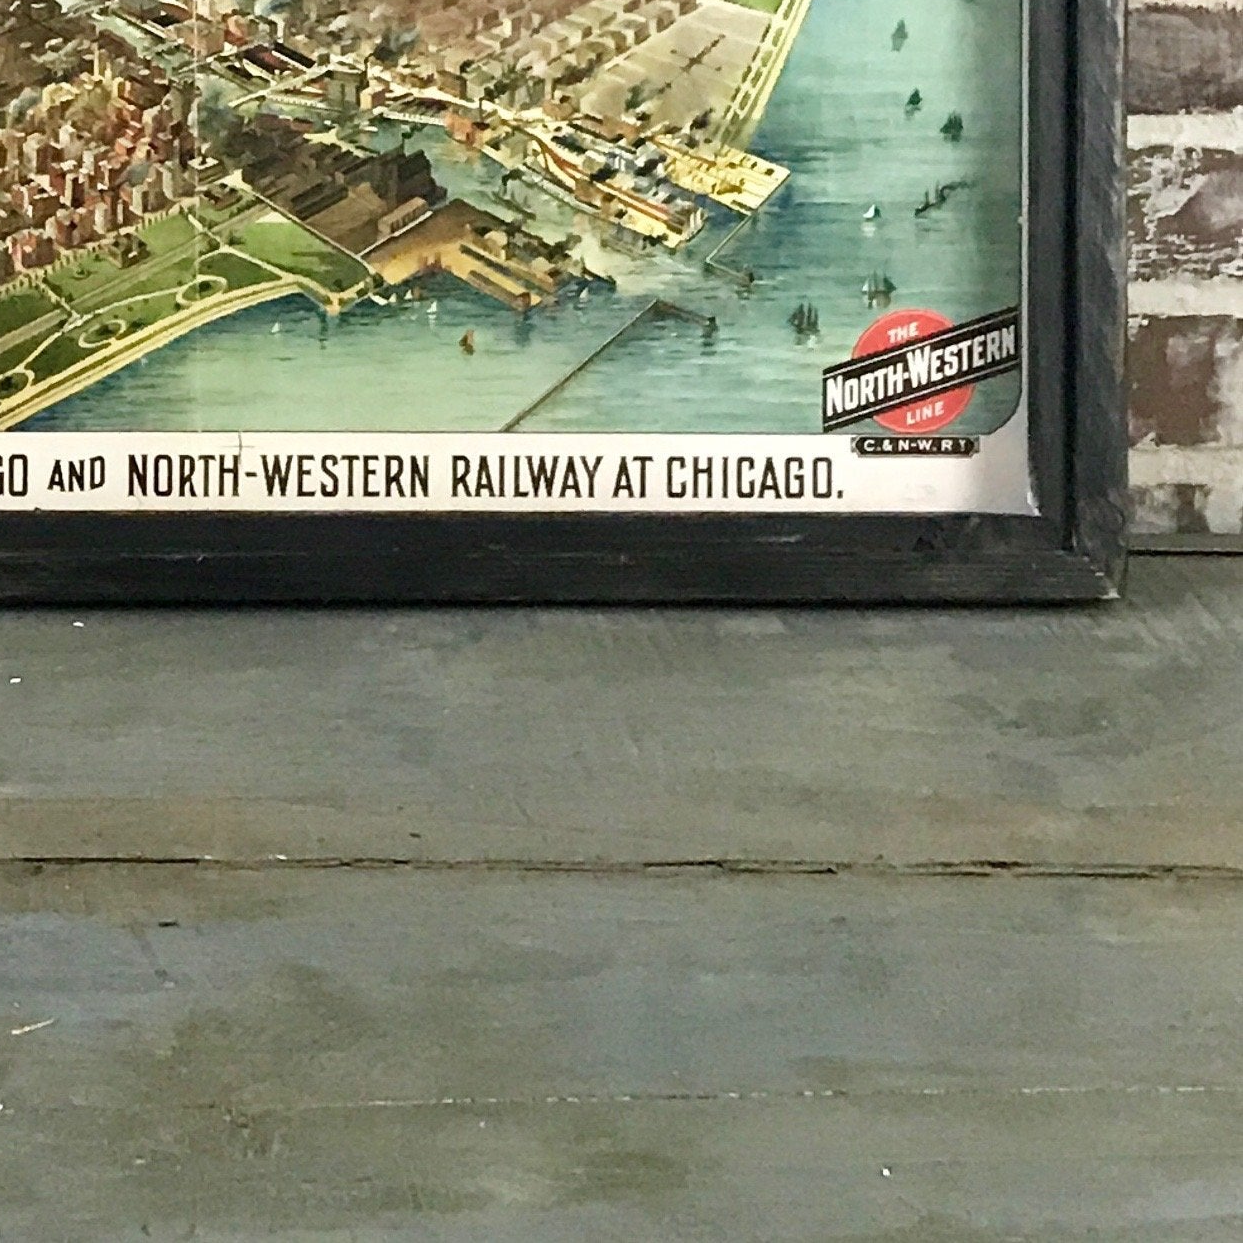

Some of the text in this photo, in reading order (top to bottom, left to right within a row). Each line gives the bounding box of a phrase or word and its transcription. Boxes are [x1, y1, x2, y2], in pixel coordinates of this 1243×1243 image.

[887, 321, 919, 343] THE
[825, 324, 1016, 418] NORTH-WESTERN
[906, 401, 945, 426] LINE
[48, 456, 105, 491] AND
[129, 455, 428, 497] NORTH-WESTERN
[453, 456, 602, 497] RAILWAY
[613, 457, 653, 497] AT
[667, 457, 842, 498] CHICAGO.
